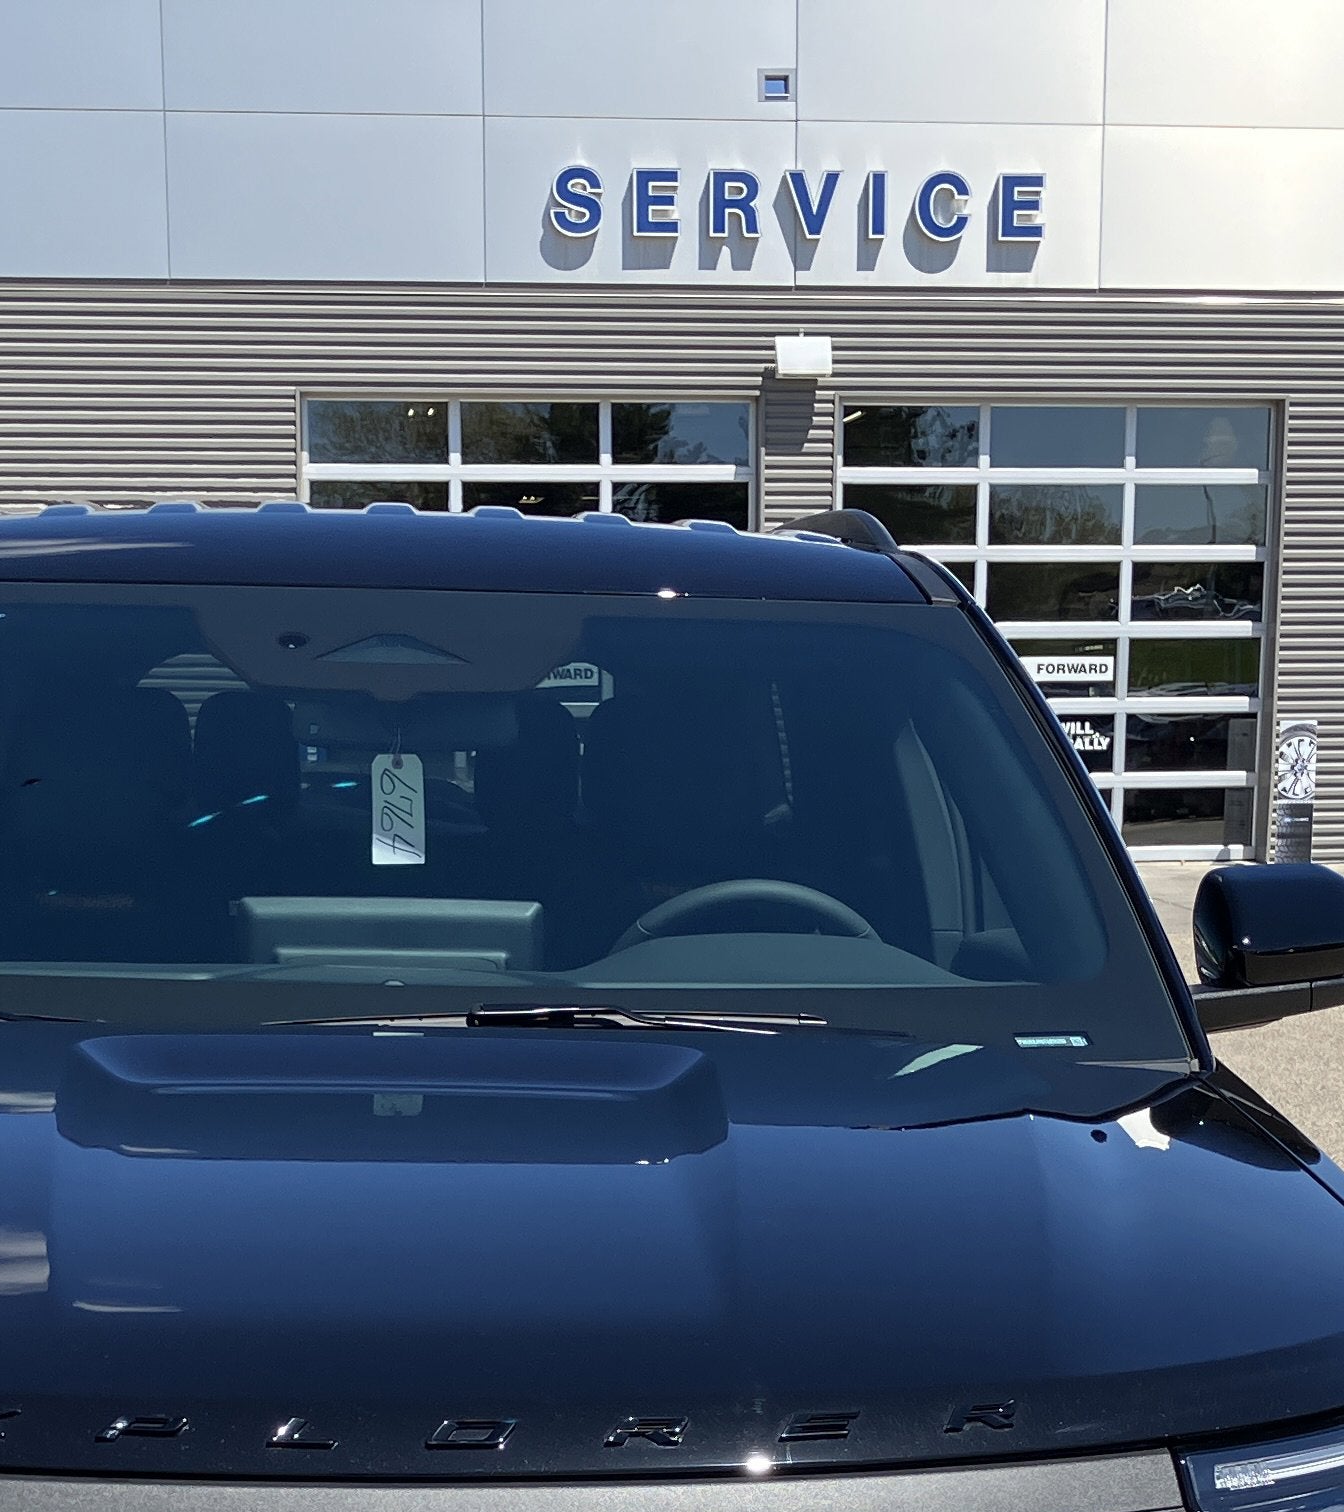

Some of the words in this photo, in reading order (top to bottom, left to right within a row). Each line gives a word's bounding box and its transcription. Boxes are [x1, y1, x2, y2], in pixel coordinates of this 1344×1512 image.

[549, 165, 1047, 242] SERVICE
[1036, 663, 1109, 675] FORWARD
[1069, 736, 1110, 750] ALLY
[376, 767, 422, 859] 6764
